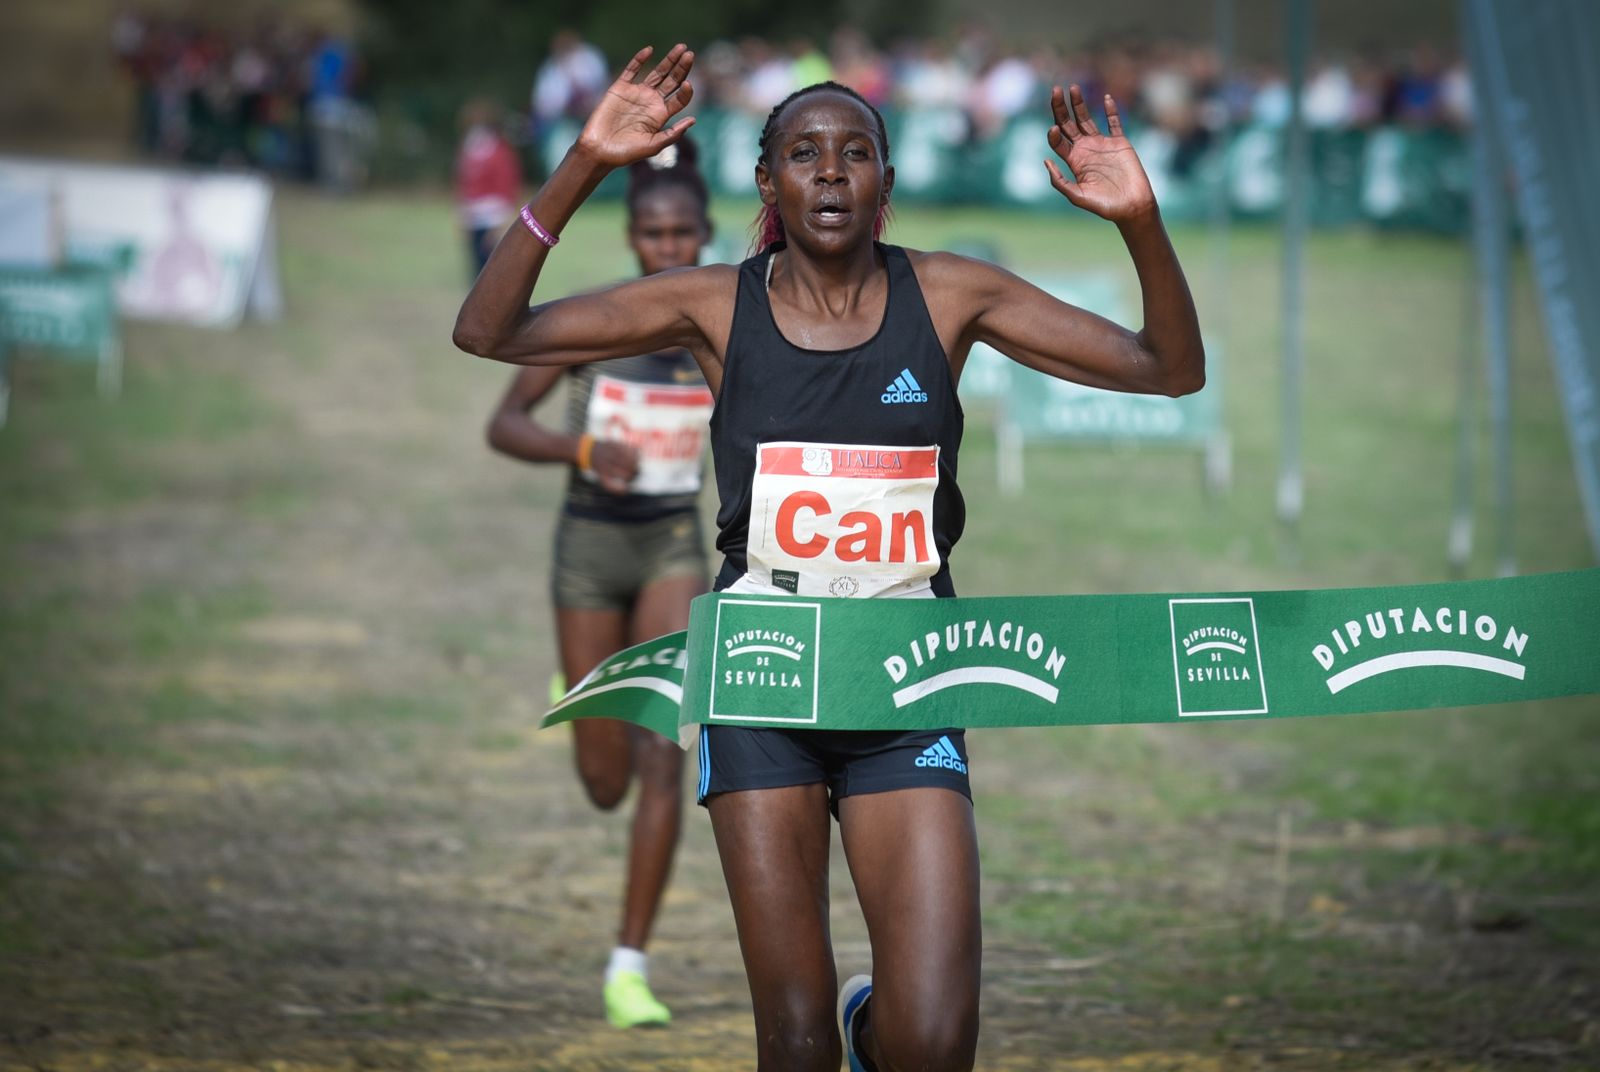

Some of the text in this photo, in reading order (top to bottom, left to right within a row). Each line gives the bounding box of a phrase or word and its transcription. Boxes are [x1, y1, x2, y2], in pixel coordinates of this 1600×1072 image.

[881, 390, 928, 404] adidas
[838, 450, 902, 469] ITALICA
[775, 490, 930, 563] Can
[725, 630, 805, 653] DIPUTACION
[1183, 627, 1248, 648] DIPUTACION
[1312, 607, 1529, 671] DIPUTACION
[757, 657, 770, 666] DE
[883, 619, 1067, 684] DIPUTACION
[1211, 653, 1222, 662] DE
[725, 670, 802, 687] SEVILLA
[1187, 667, 1251, 682] SEVILLA
[914, 754, 967, 775] adidas
